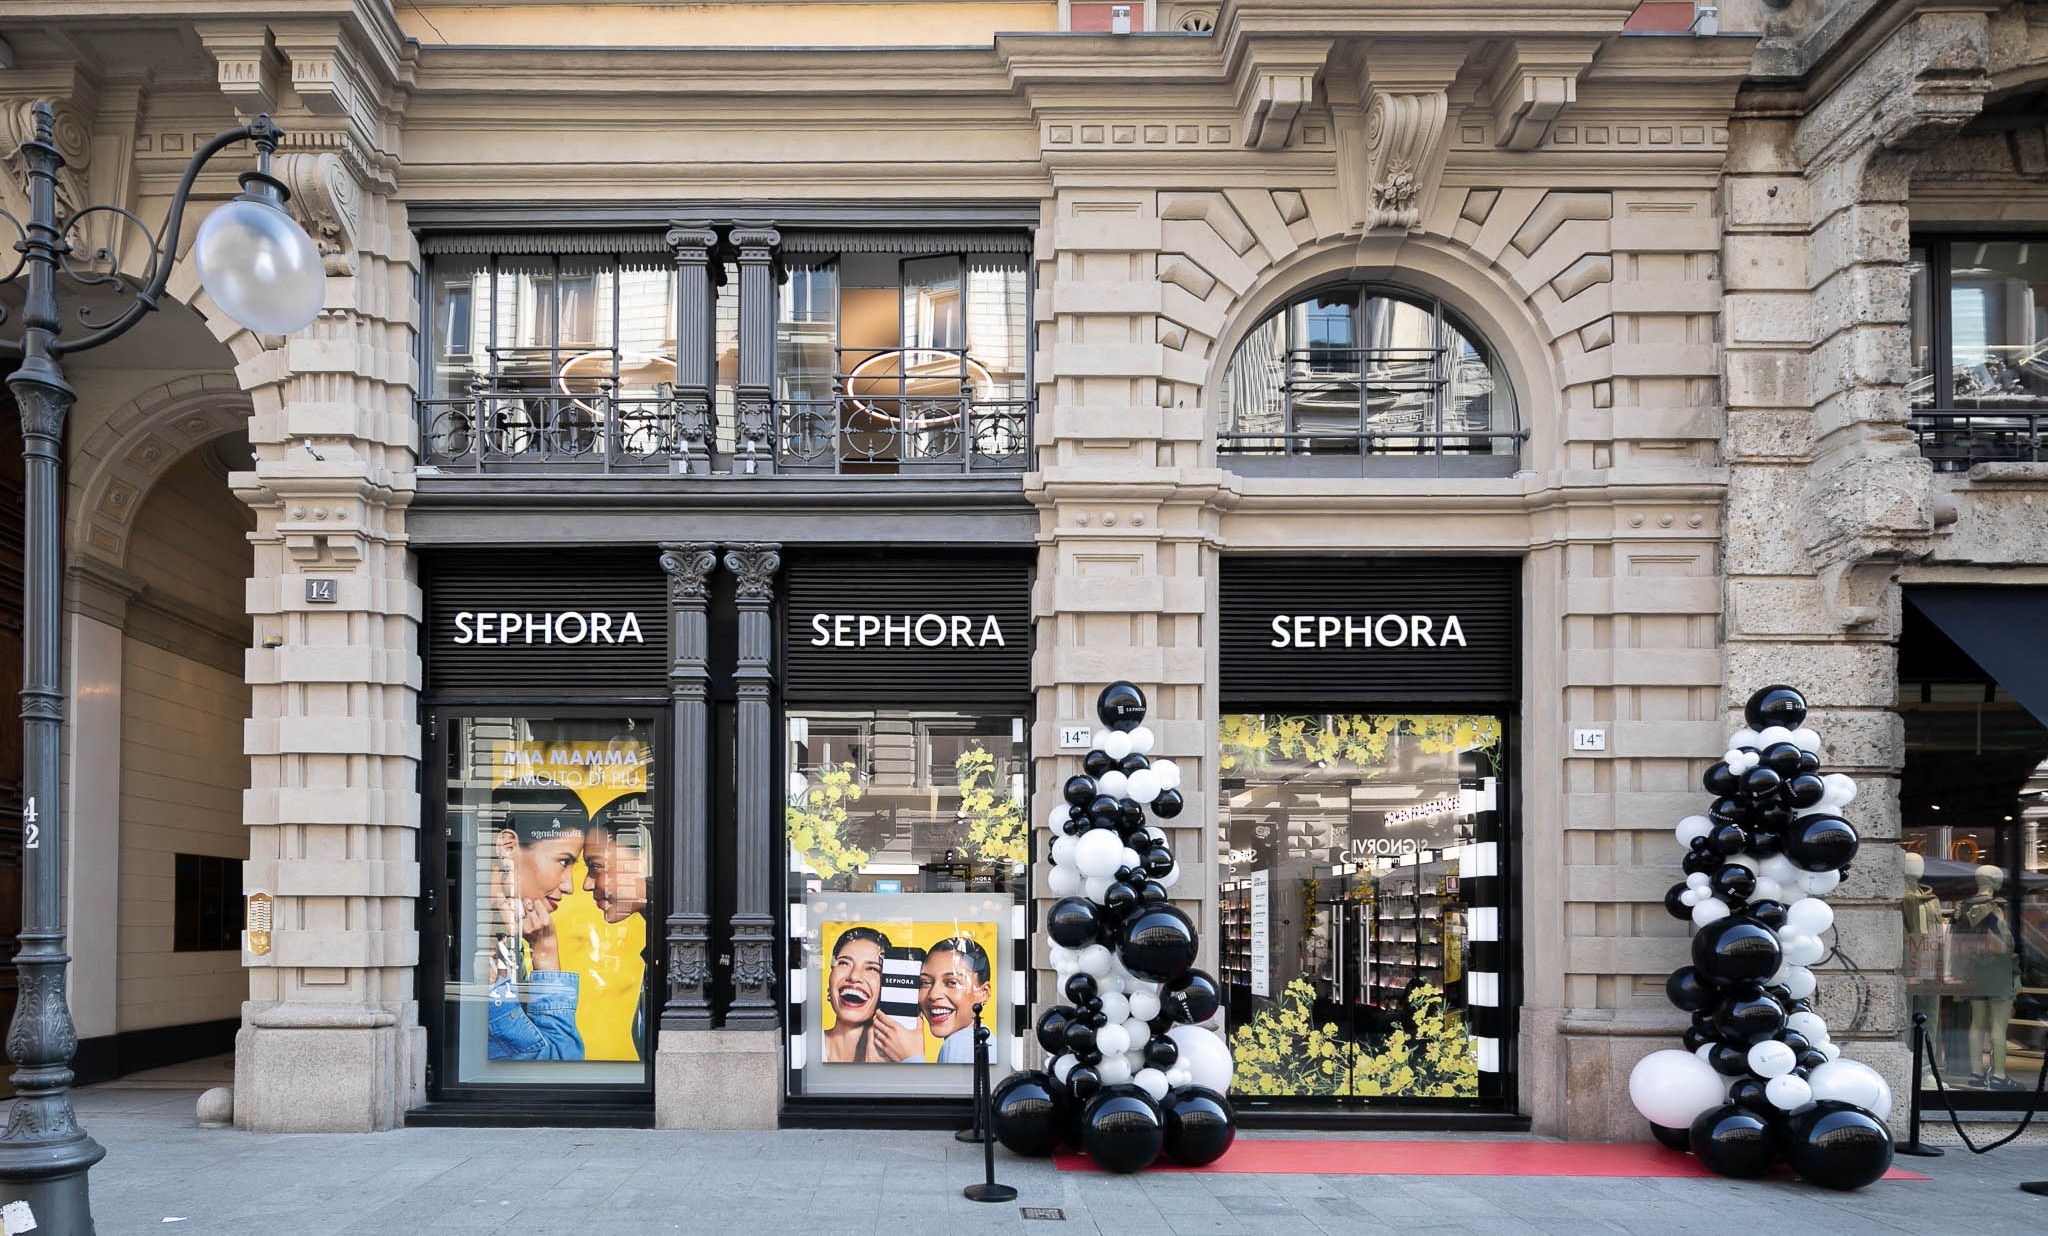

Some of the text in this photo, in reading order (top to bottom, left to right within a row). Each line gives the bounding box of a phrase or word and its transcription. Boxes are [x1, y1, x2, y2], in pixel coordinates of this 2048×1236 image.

[311, 581, 330, 599] 14
[453, 611, 645, 645] SEPHORA
[810, 613, 1005, 647] SEPHORA
[1271, 614, 1467, 648] SEPHORA
[504, 749, 544, 765] MIA
[519, 770, 582, 787] MOLTO
[588, 770, 605, 787] DI
[1384, 796, 1460, 826] WOMEN FRAGRANCES
[885, 977, 914, 985] SEPHORA
